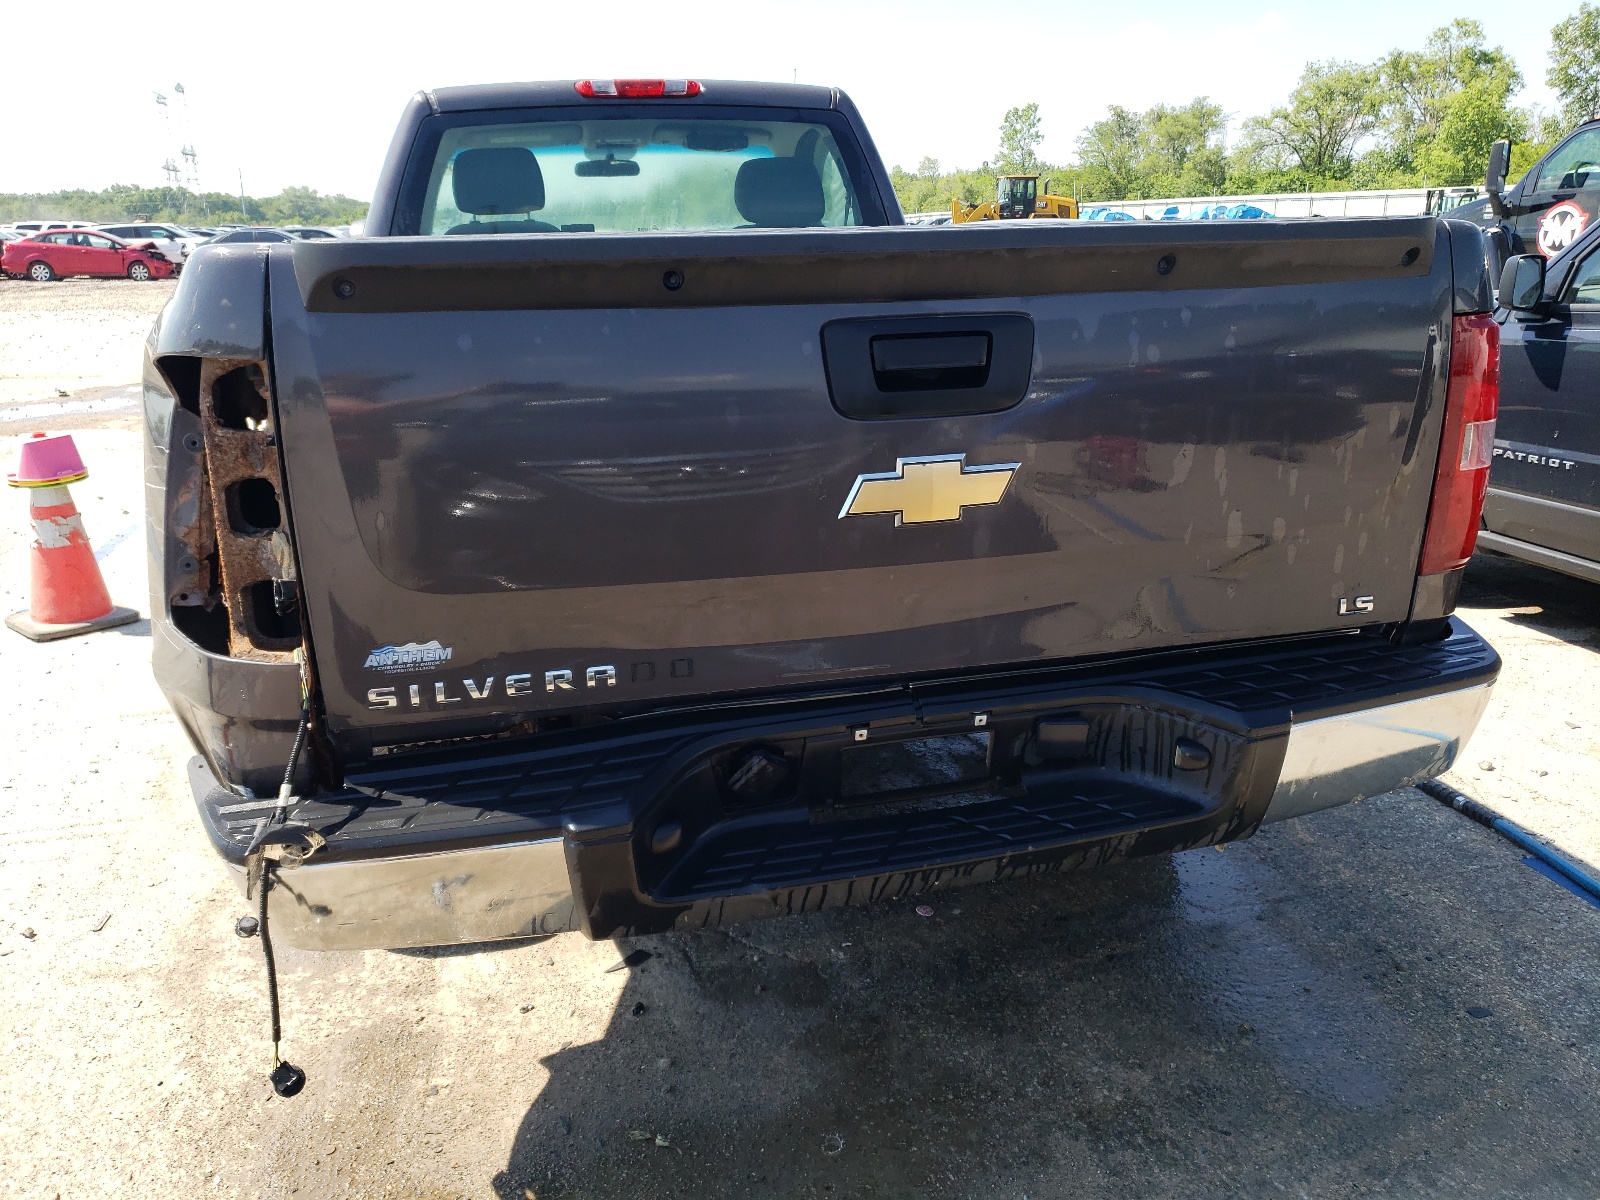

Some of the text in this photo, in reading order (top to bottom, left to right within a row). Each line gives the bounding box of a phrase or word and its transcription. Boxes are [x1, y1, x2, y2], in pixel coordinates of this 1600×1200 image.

[1493, 448, 1575, 470] PATRIOT
[1339, 596, 1374, 615] LS
[364, 647, 453, 668] ANTHEM
